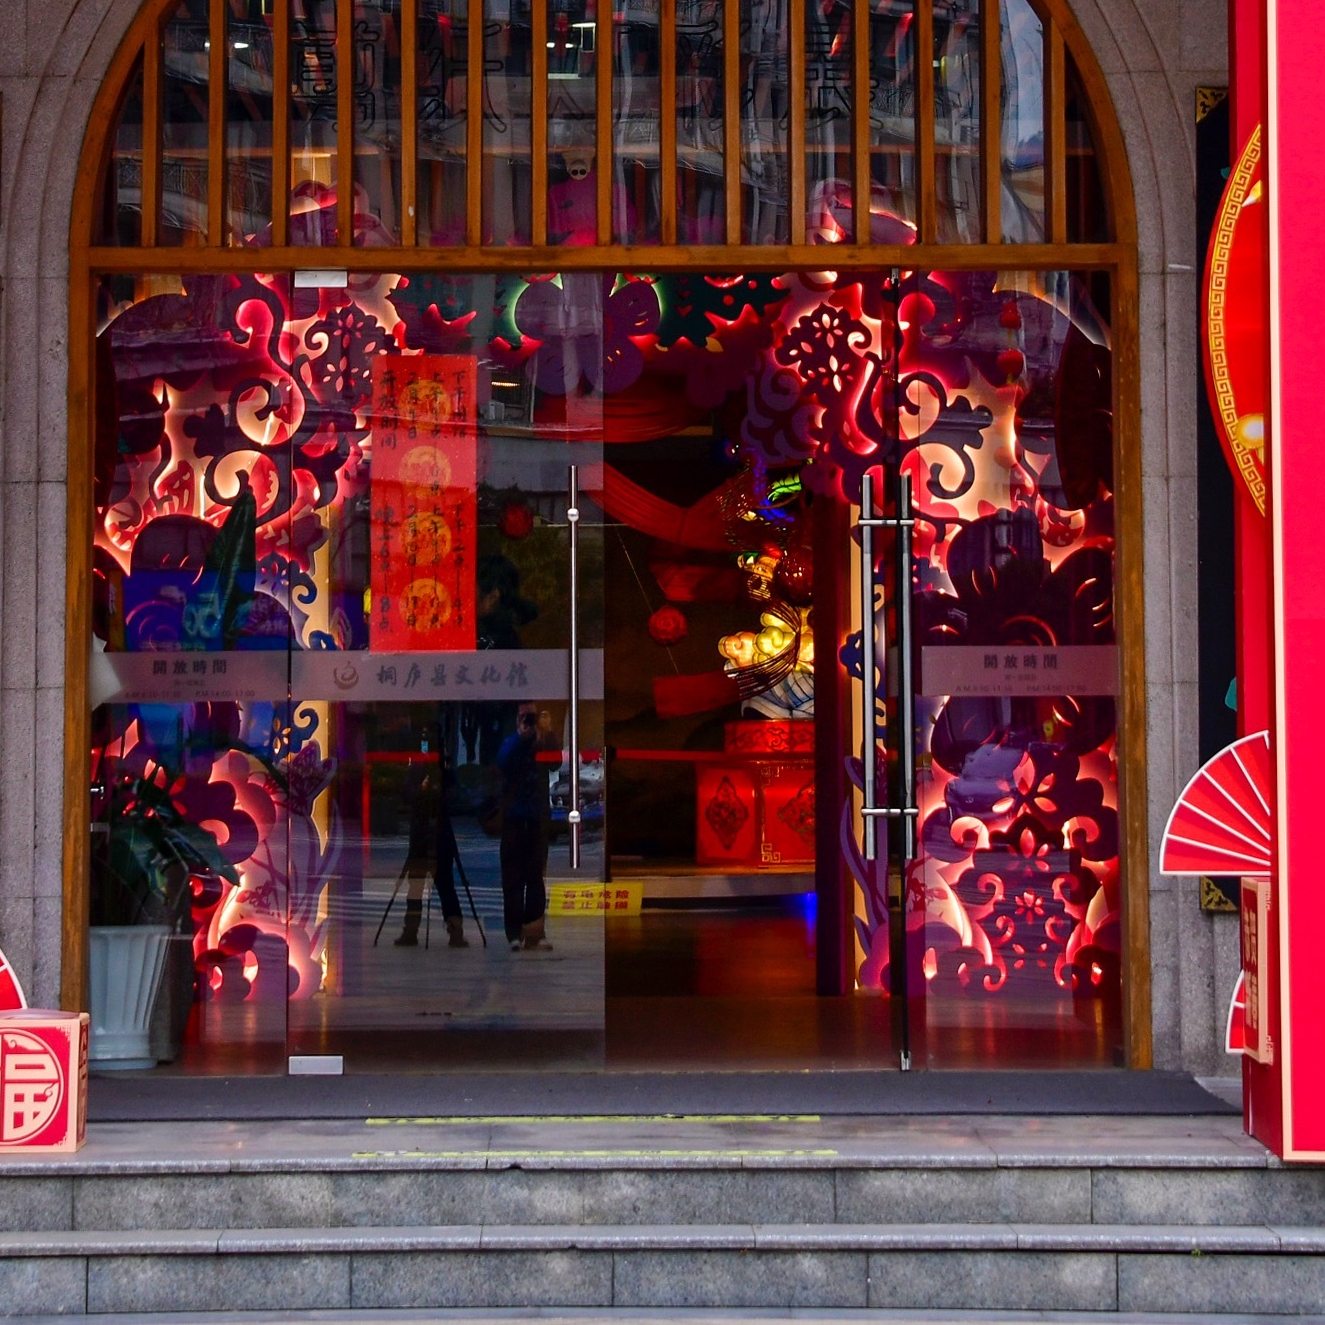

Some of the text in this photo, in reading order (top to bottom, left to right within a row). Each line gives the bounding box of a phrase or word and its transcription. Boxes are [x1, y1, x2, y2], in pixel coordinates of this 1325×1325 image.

[376, 661, 530, 688] 桐庐县文化馆
